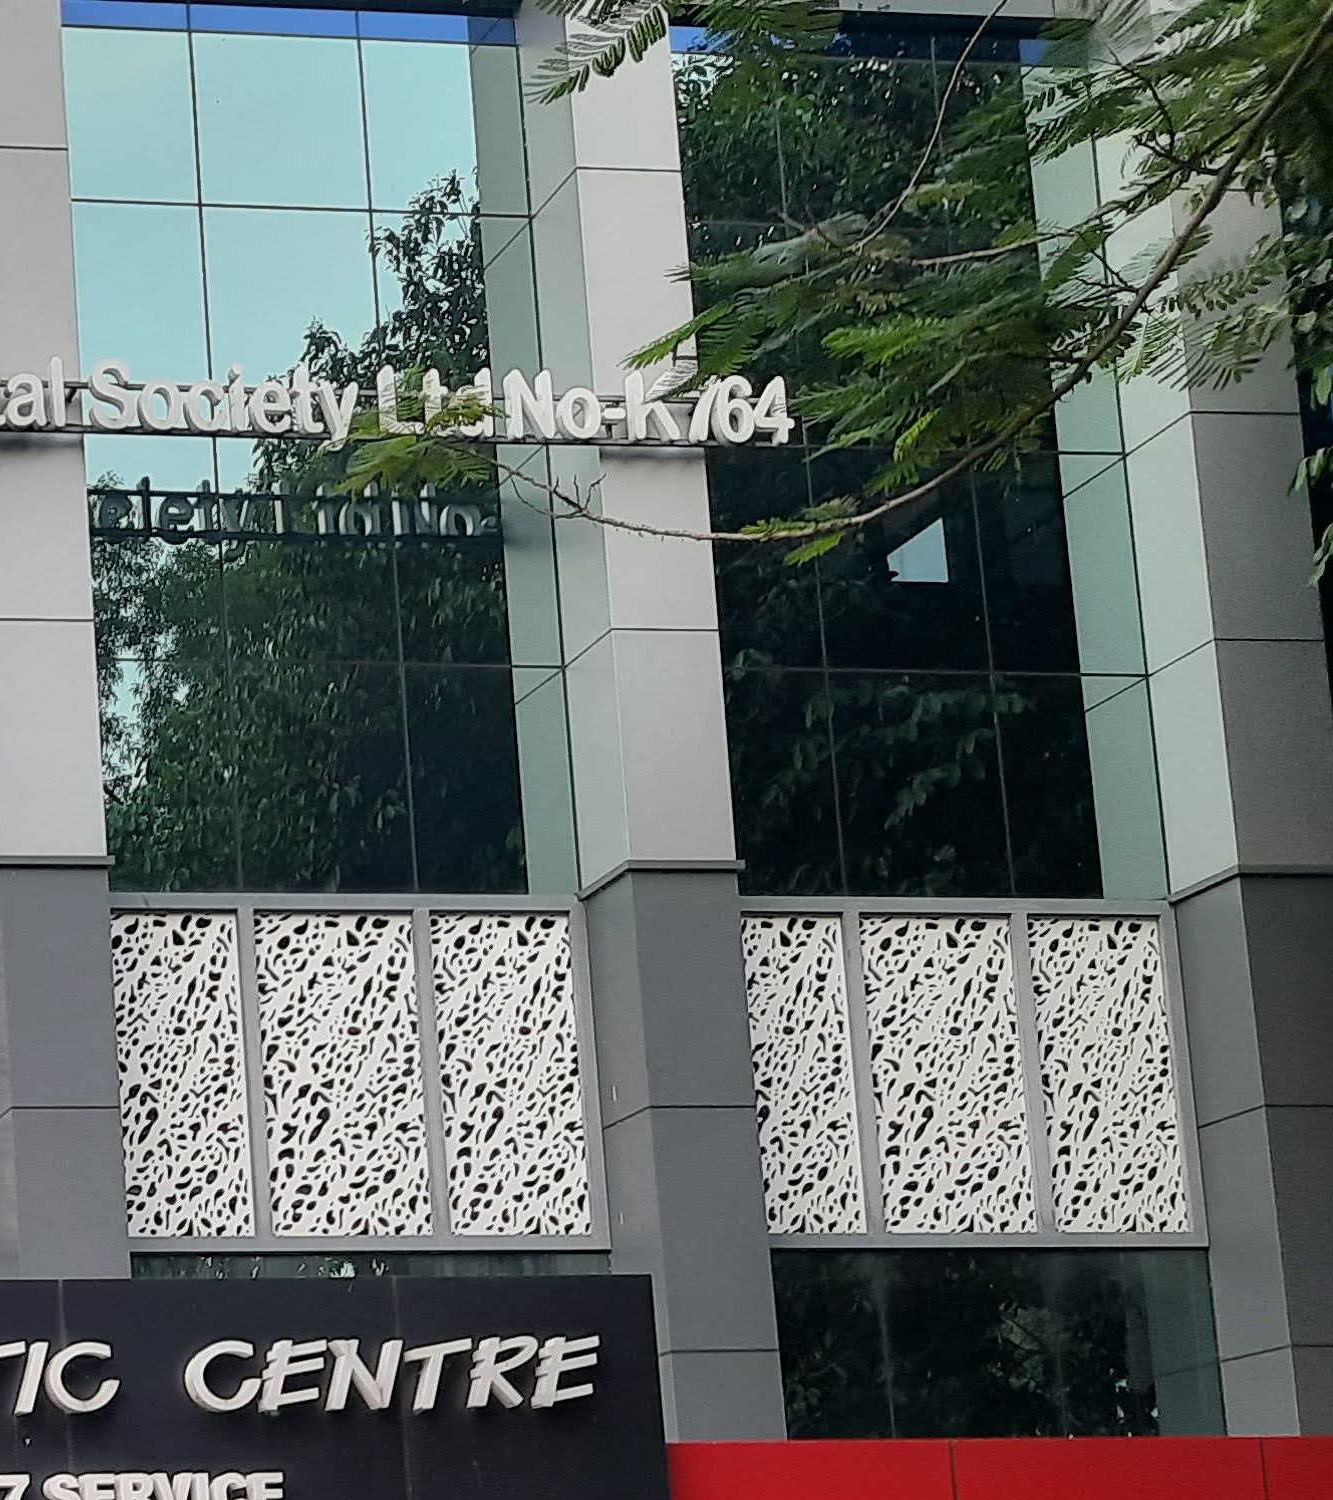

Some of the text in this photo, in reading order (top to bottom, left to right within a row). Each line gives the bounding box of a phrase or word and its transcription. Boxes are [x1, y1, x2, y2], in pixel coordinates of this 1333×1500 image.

[88, 359, 359, 451] Society
[376, 364, 496, 439] Ltd
[183, 1335, 600, 1412] CENTRE
